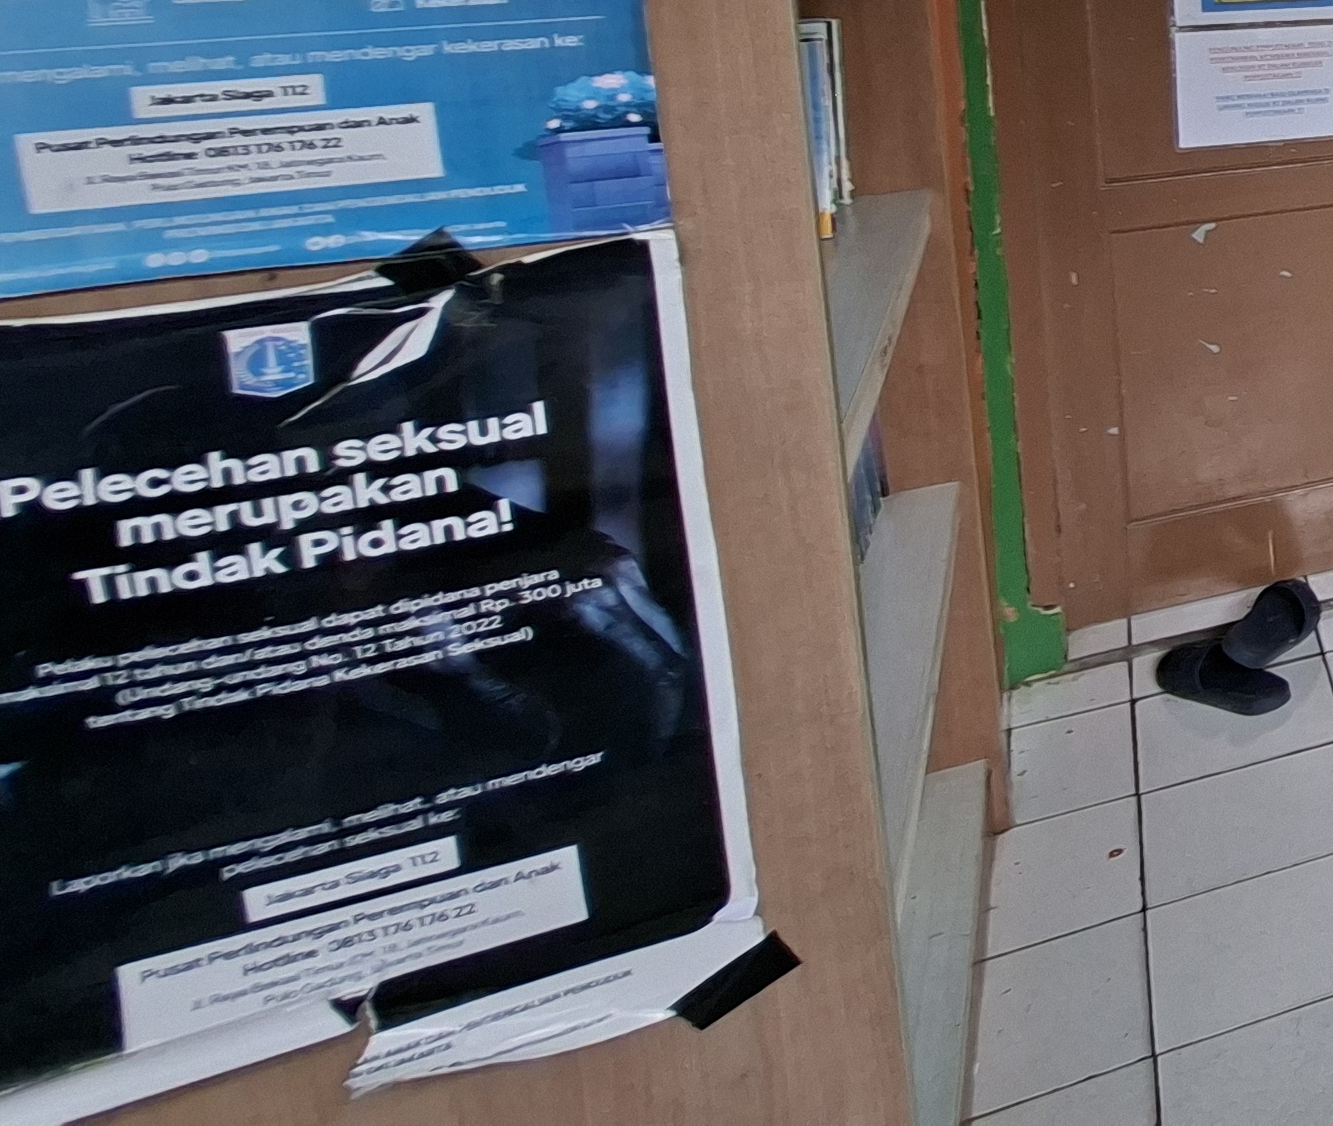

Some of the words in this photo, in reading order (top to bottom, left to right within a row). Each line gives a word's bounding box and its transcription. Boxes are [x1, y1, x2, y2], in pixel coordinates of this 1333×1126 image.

[307, 44, 438, 61] mendengar
[443, 36, 549, 54] kekerasan
[376, 114, 420, 126] Anak
[0, 446, 320, 518] Pelecehan
[331, 400, 548, 467] seksual
[116, 466, 459, 547] merupakan
[70, 541, 290, 604] Tindak
[296, 498, 515, 569] Pidana!
[483, 569, 560, 598] penjara
[517, 583, 562, 605] 300
[564, 576, 602, 598] juta
[353, 644, 379, 659] 12
[448, 614, 502, 638] 2022
[485, 750, 605, 792] mendengar
[410, 851, 442, 868] 112
[513, 860, 562, 883] Anak
[452, 902, 476, 919] 22
